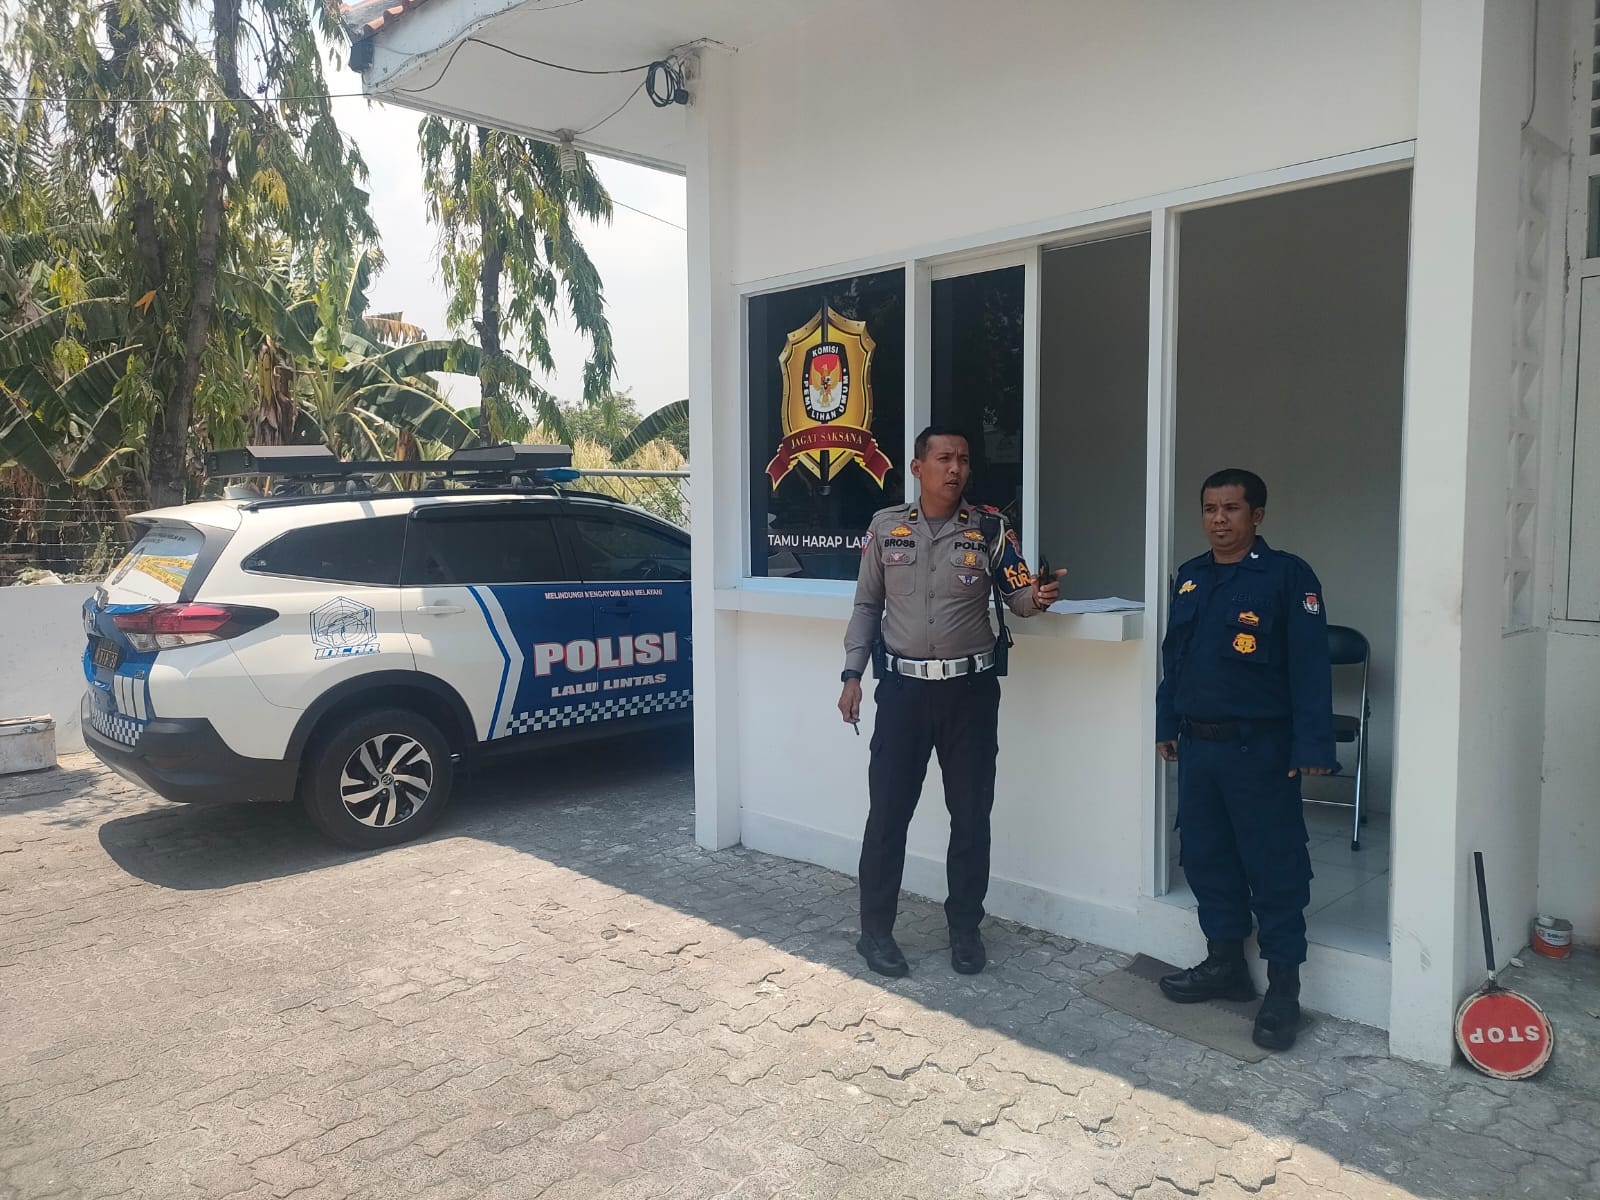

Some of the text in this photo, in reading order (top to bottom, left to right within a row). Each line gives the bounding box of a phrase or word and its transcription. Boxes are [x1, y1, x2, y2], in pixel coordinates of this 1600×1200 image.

[812, 345, 839, 357] KOMISI
[839, 375, 849, 413] UMUM
[791, 431, 862, 449] JAGAT SAKSANA
[768, 534, 799, 547] TAMU
[802, 535, 843, 548] HARAP
[621, 589, 635, 597] DAN
[533, 631, 677, 677] POLISI
[551, 673, 667, 697] LALU LINTAS
[1469, 1025, 1541, 1044] STOP
